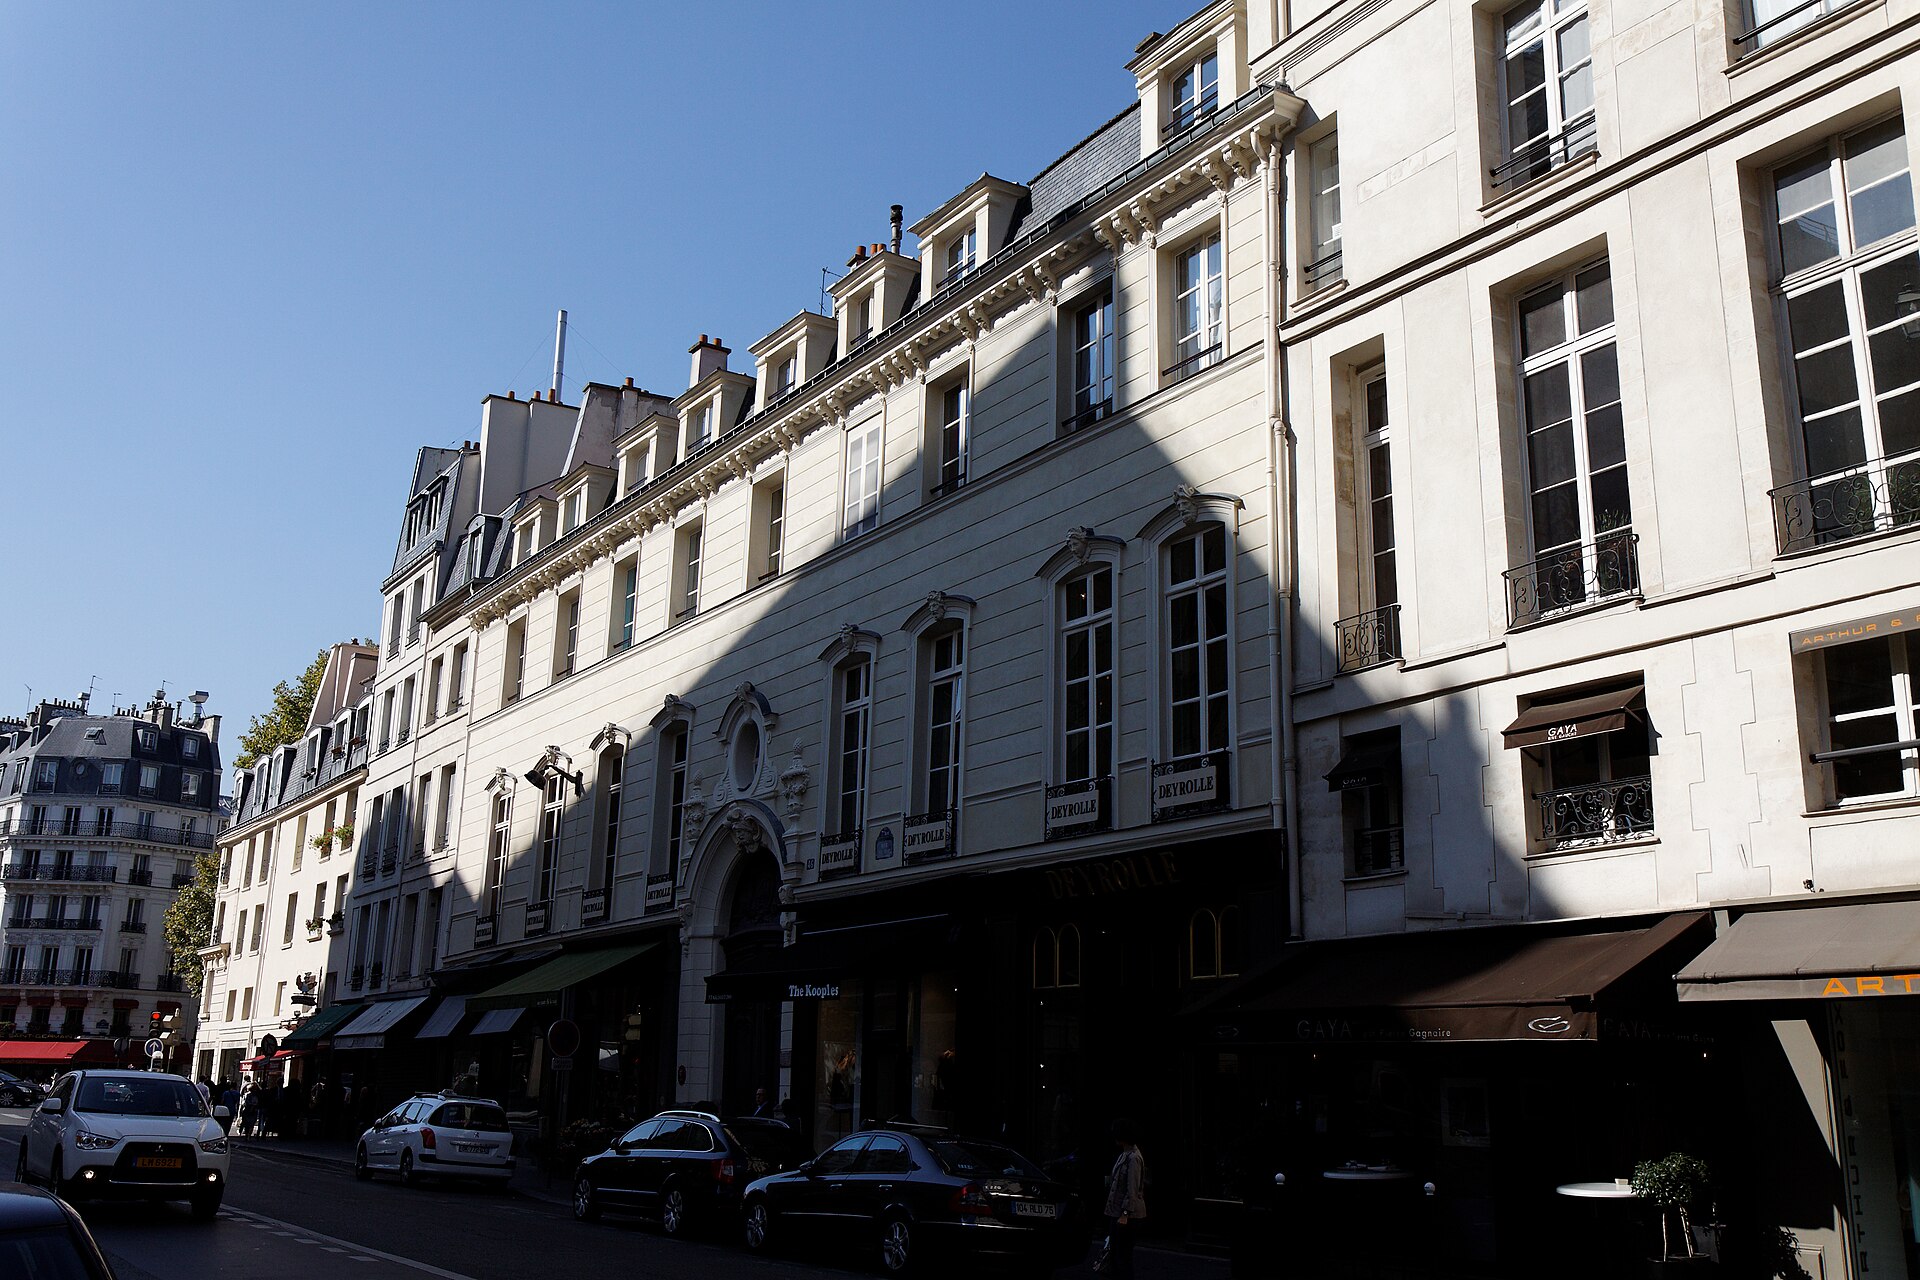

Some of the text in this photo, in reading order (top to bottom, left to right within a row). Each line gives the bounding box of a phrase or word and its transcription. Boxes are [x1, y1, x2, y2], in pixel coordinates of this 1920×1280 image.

[1801, 623, 1877, 645] ARTHUR
[1547, 723, 1577, 737] GAYA
[1158, 775, 1214, 800] DEYROLLE
[1051, 799, 1097, 820] DEYROLLE
[908, 828, 945, 847] DEYROLLE
[821, 847, 854, 865] DEYROLLE
[1044, 851, 1183, 899] DEYROLLE
[647, 886, 671, 900] DEYROLLE
[788, 983, 839, 999] The Kooples
[1822, 974, 1920, 997] ART
[1296, 1018, 1353, 1040] GAYA
[1408, 1027, 1451, 1040] Gagnaire
